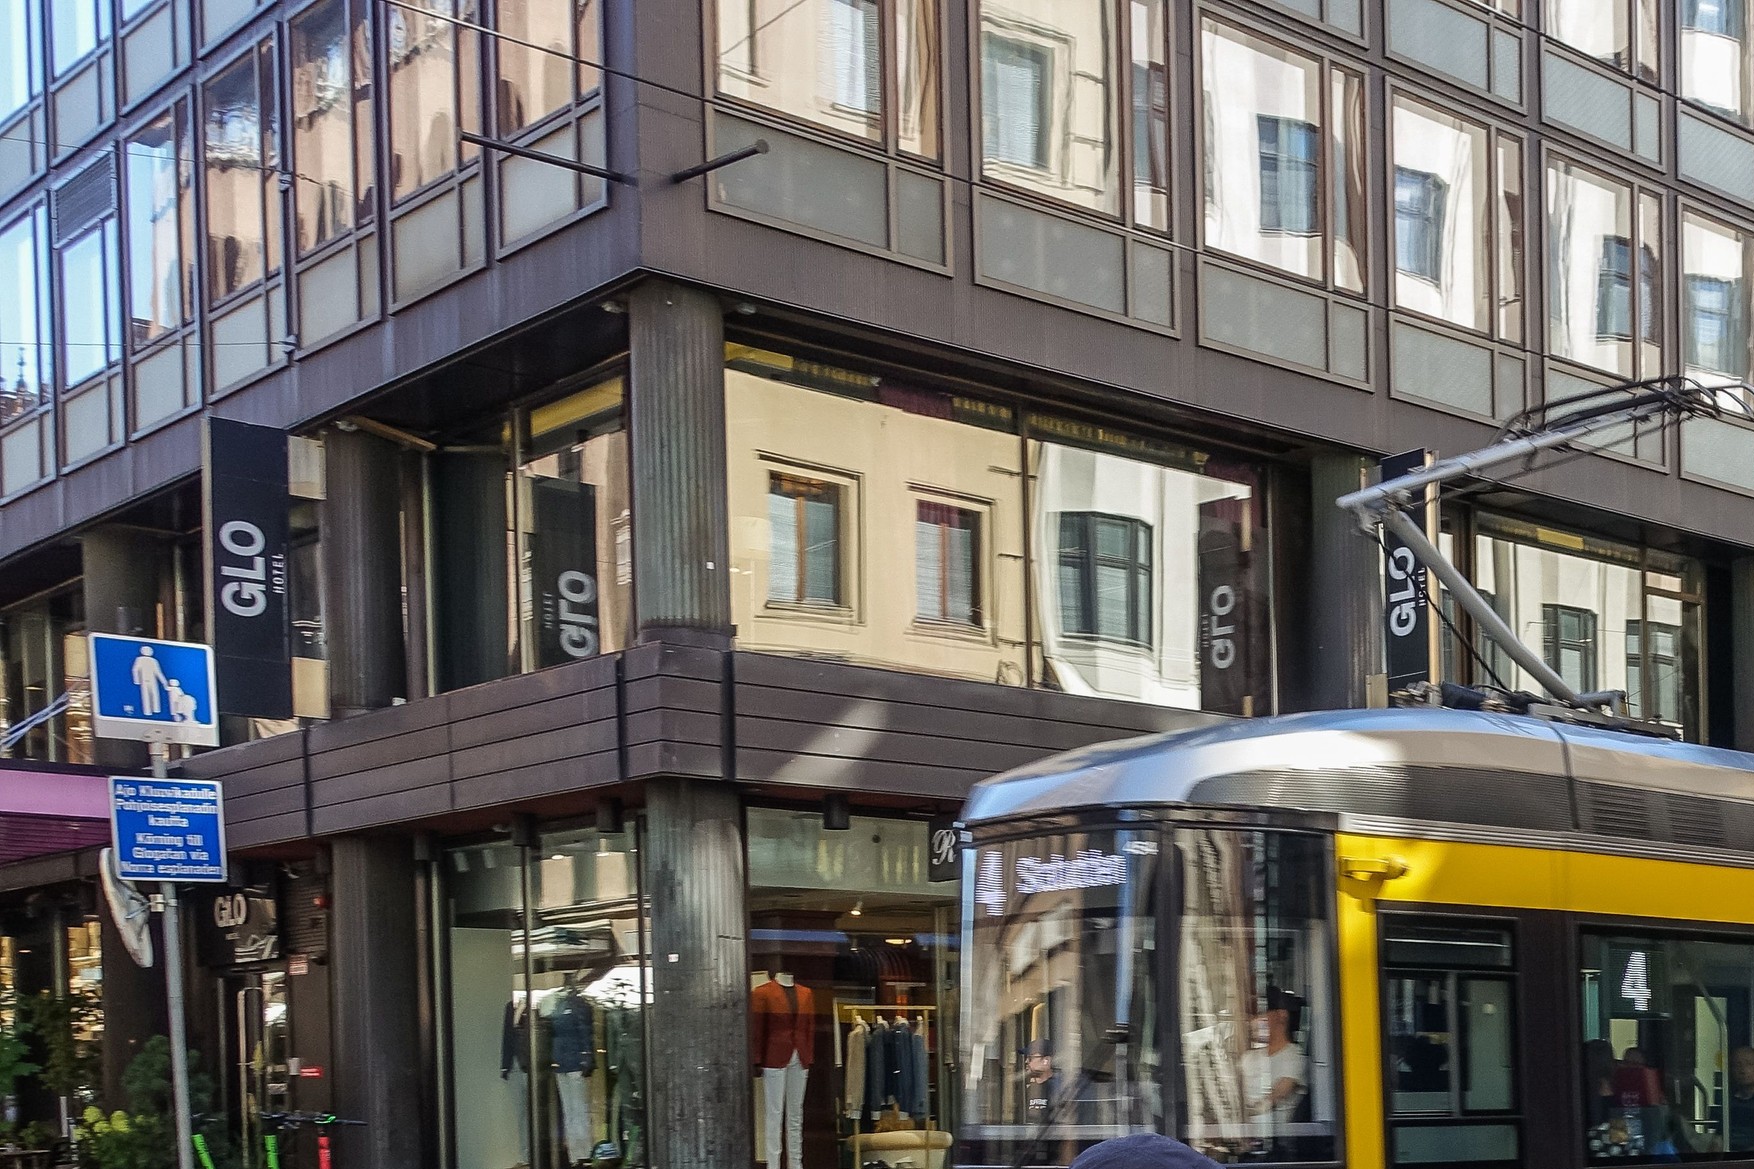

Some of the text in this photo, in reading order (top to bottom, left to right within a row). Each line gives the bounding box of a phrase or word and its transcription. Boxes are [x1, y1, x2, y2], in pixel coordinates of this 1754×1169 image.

[219, 520, 267, 617] GLO
[271, 553, 285, 594] HOTEL
[1388, 546, 1417, 637] GLO
[214, 893, 247, 928] GLO
[975, 850, 1008, 916] 4
[1621, 951, 1652, 1011] 4
